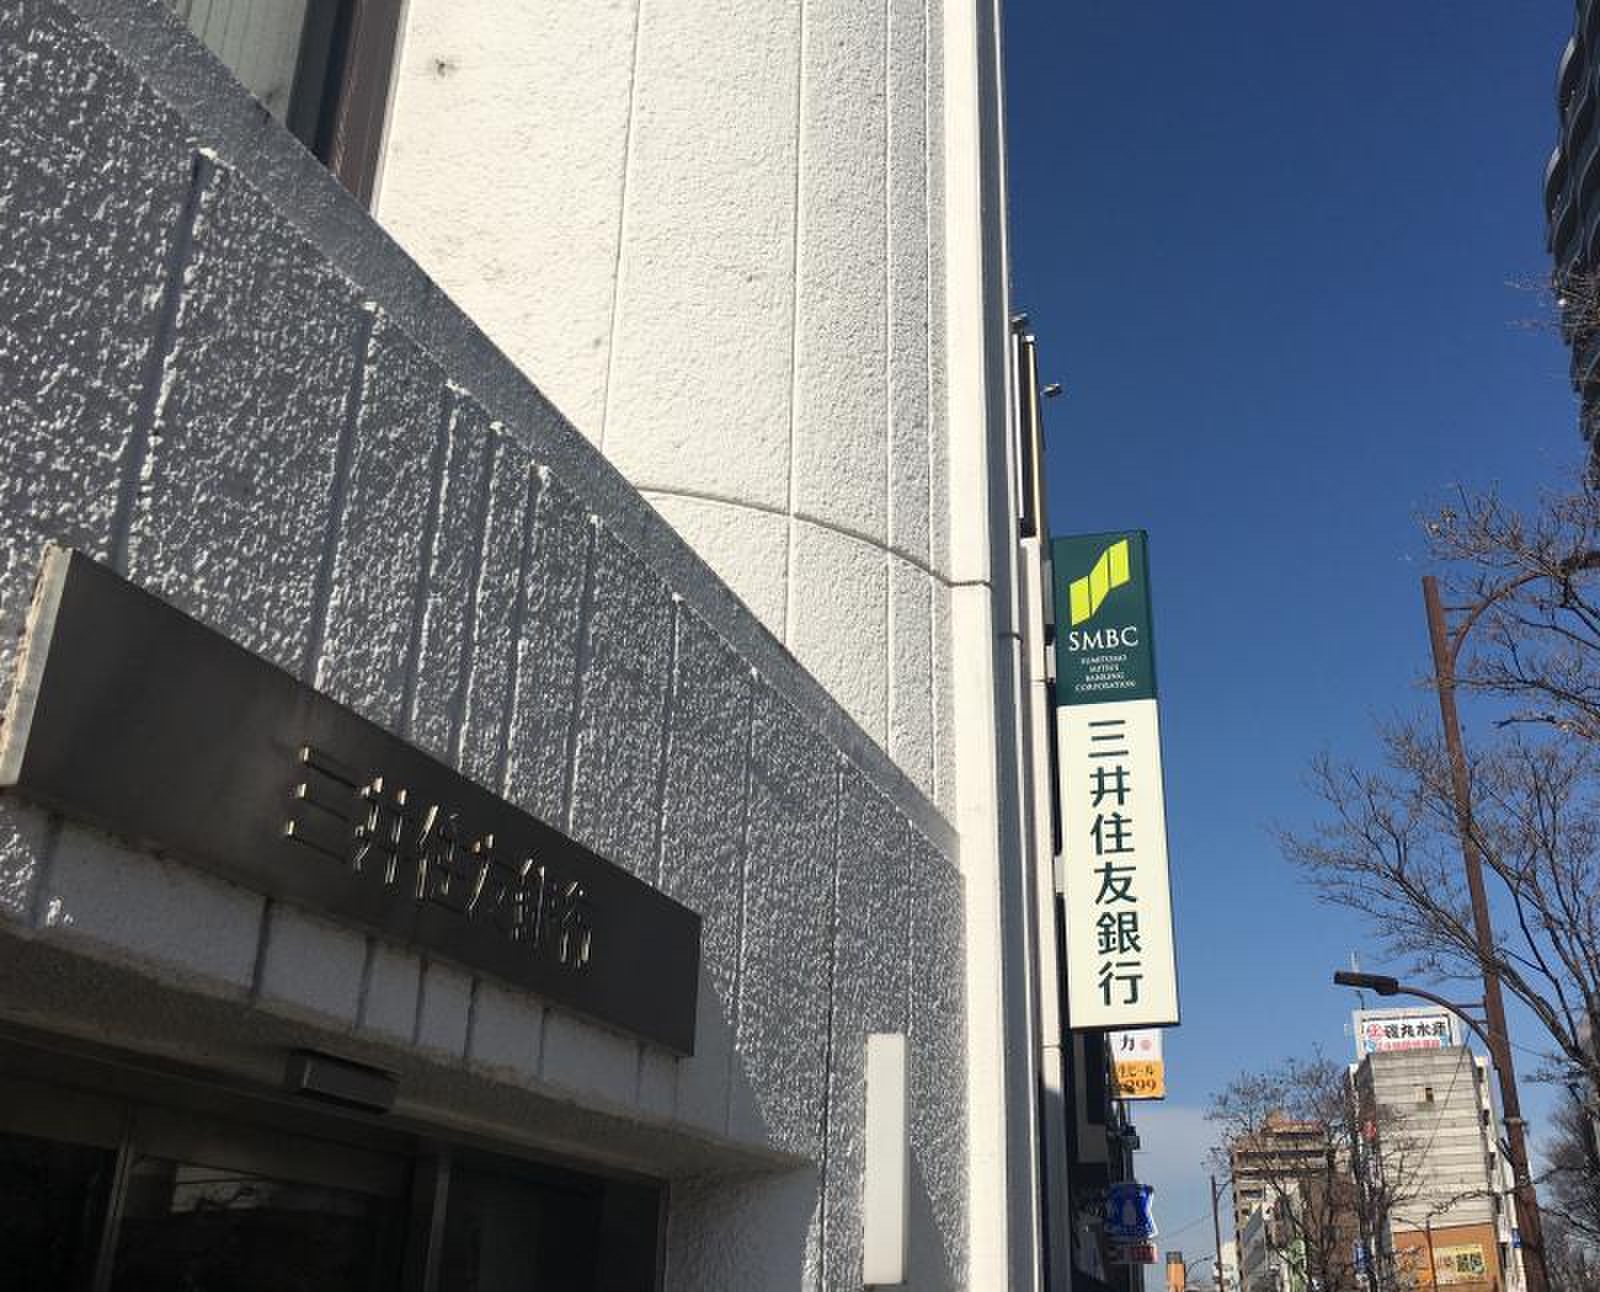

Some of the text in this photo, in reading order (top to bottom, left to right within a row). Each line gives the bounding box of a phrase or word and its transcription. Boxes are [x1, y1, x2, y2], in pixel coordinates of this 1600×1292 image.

[1068, 626, 1139, 651] SMBC
[1088, 720, 1143, 1006] 三井住友銀行
